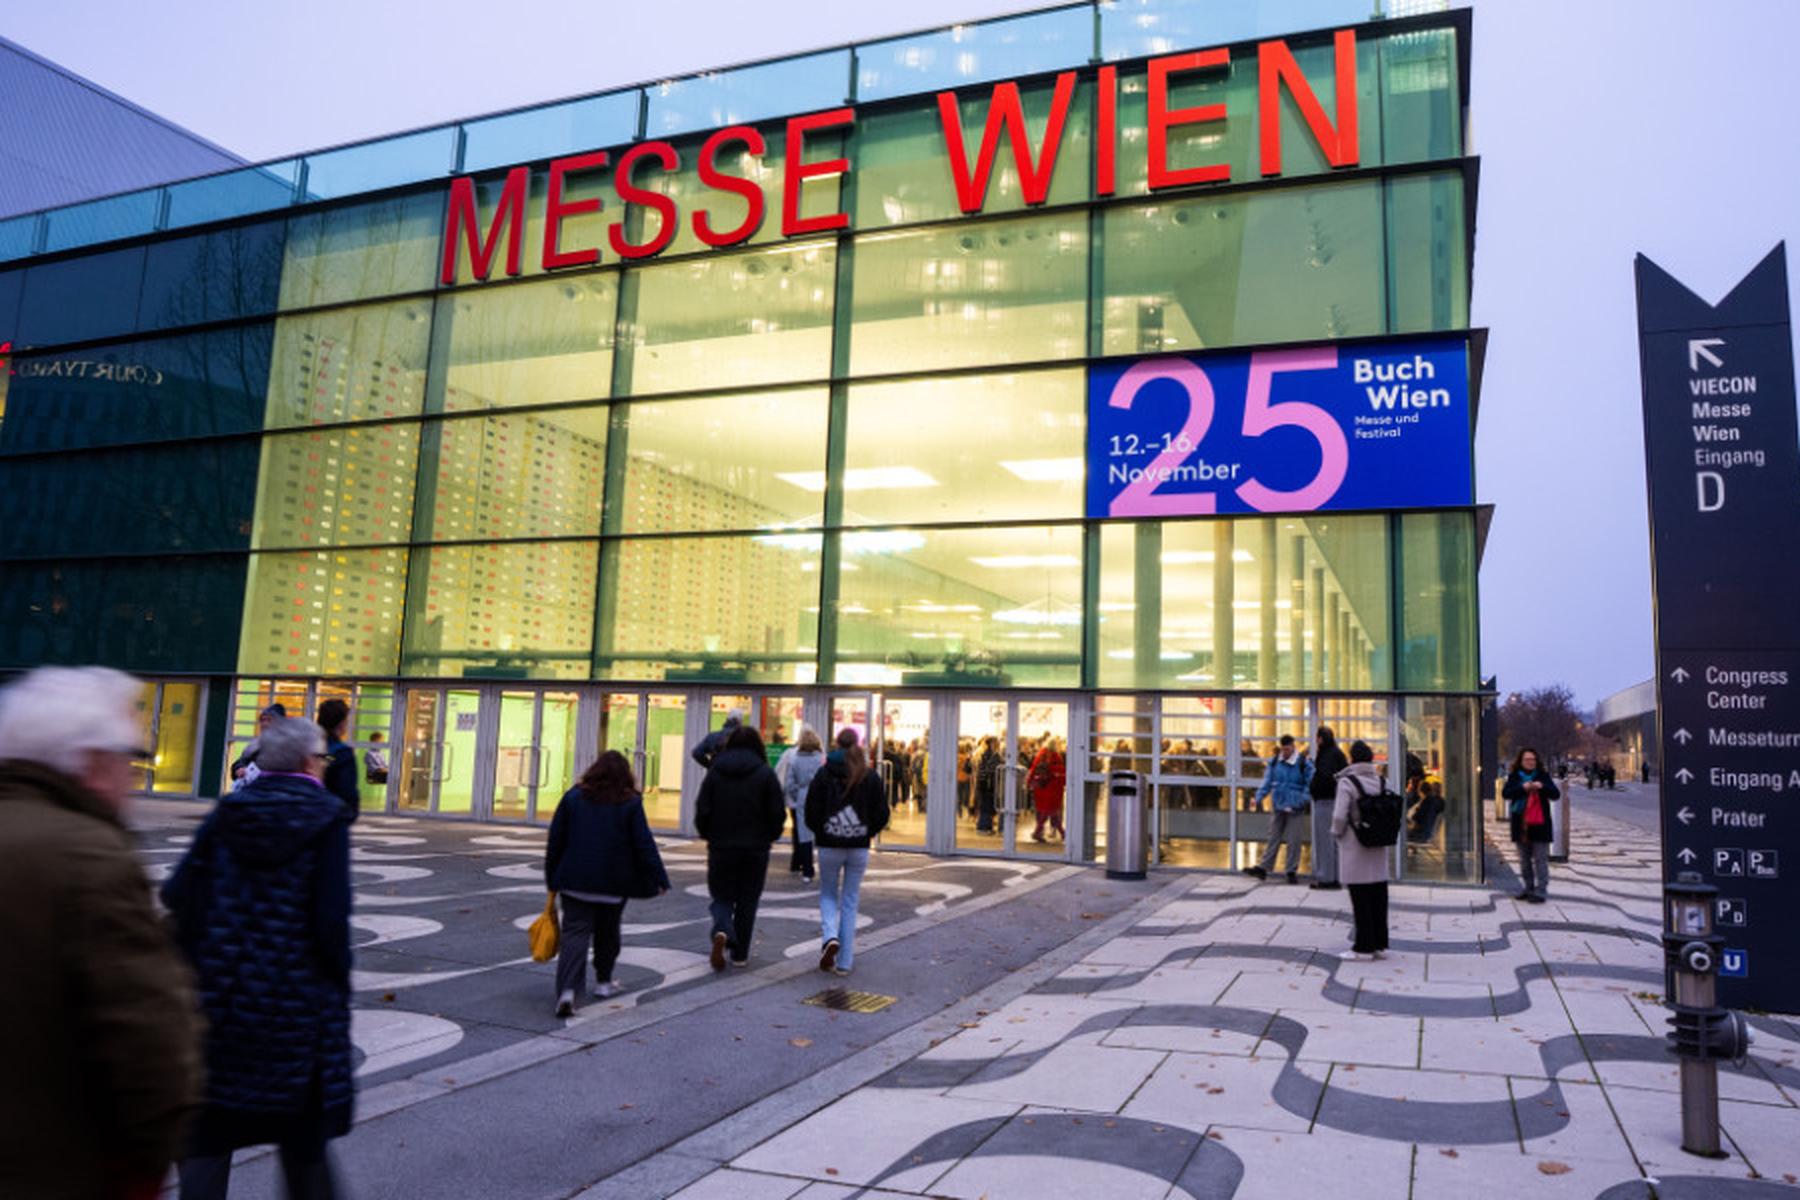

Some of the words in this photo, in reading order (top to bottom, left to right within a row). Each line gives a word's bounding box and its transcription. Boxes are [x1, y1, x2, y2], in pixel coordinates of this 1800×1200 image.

[441, 107, 856, 285] MESSE
[937, 29, 1360, 214] WIEN
[1354, 354, 1435, 383] Buch
[1689, 376, 1757, 395] VIECON
[1366, 384, 1450, 410] Wien
[1354, 416, 1392, 425] Messe
[1395, 412, 1419, 424] und
[1692, 402, 1752, 419] Messe
[1108, 346, 1349, 517] 25
[1355, 427, 1401, 439] Festival
[1692, 425, 1741, 441] Wien
[1695, 449, 1766, 468] Eingang
[1109, 459, 1241, 484] November
[1696, 471, 1726, 512] D
[1705, 665, 1788, 688] Congress
[1707, 691, 1766, 709] Center
[1710, 767, 1783, 792] Eingang
[1788, 770, 1800, 788] A
[1711, 807, 1766, 828] Prater
[1716, 851, 1730, 868] P
[1718, 900, 1731, 918] P
